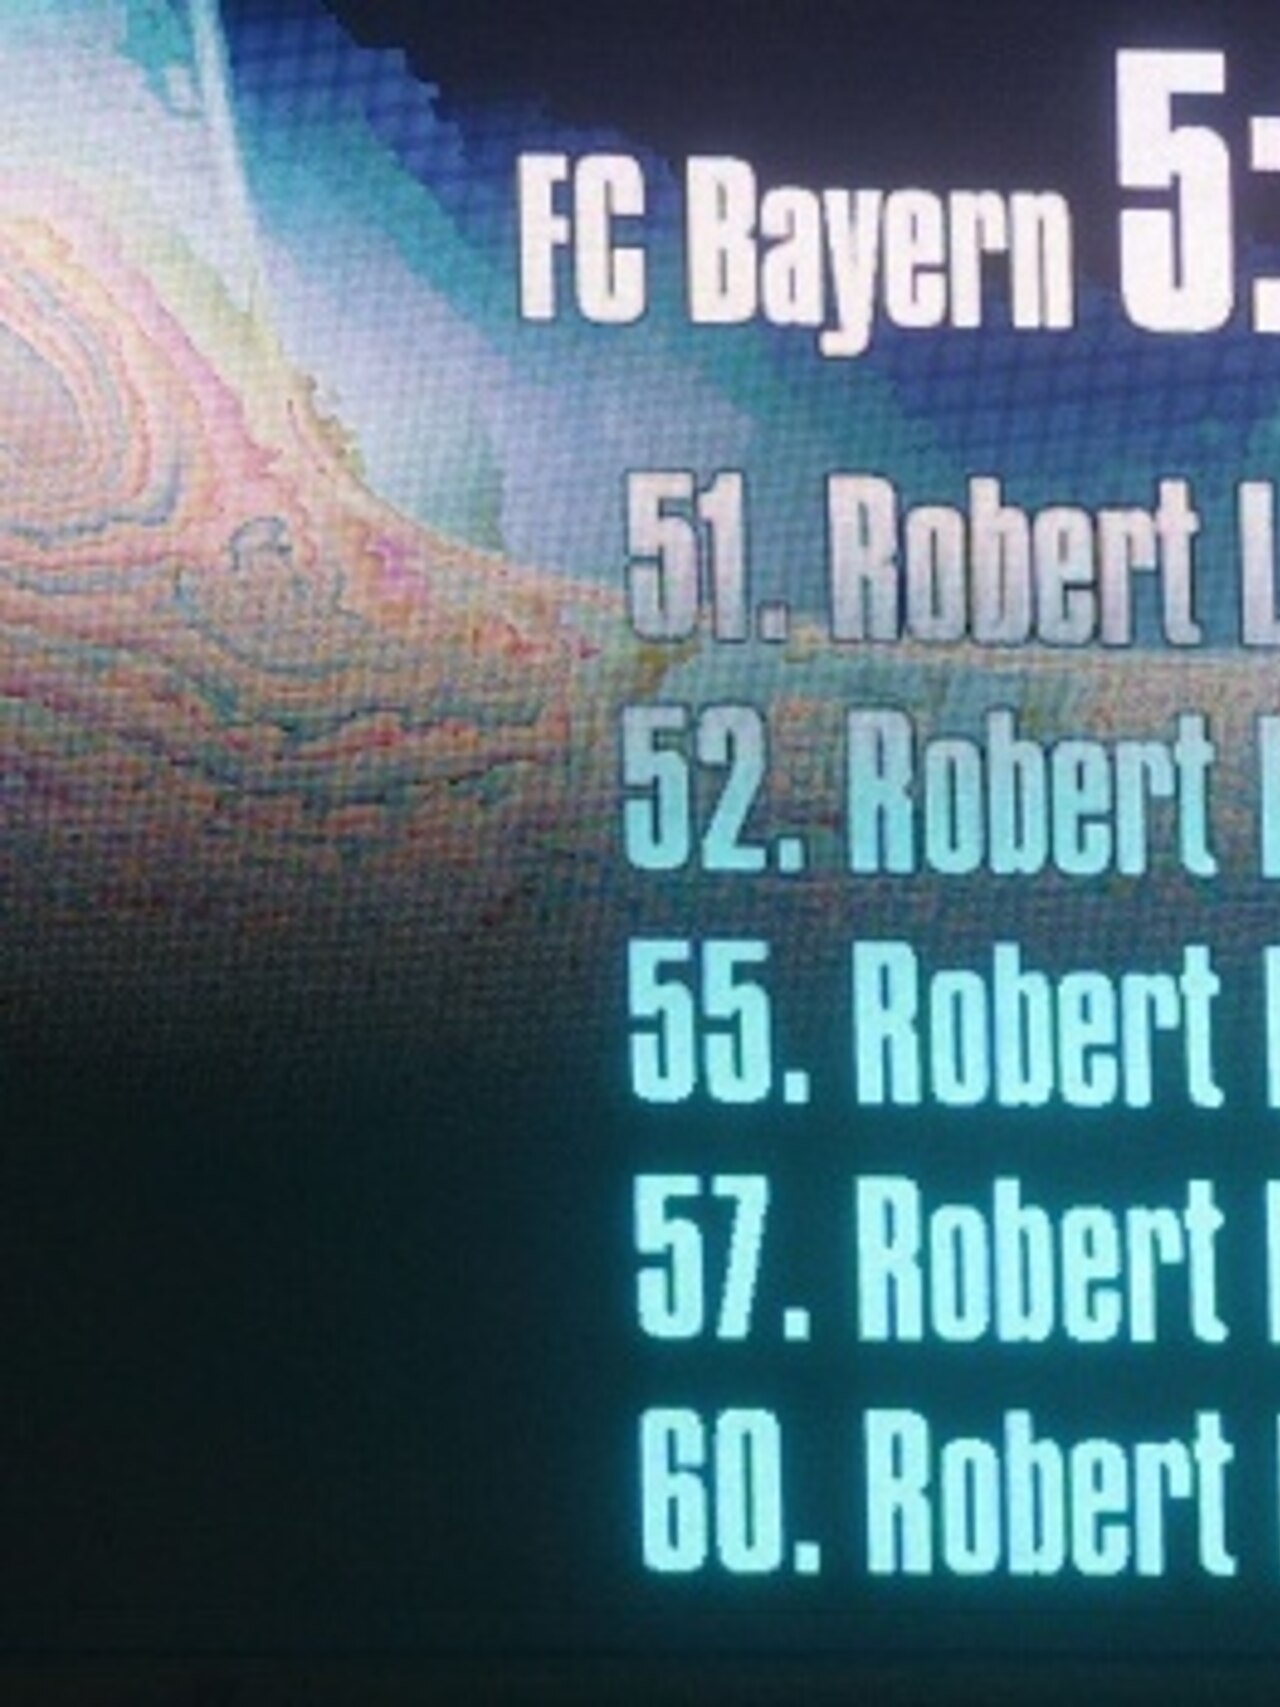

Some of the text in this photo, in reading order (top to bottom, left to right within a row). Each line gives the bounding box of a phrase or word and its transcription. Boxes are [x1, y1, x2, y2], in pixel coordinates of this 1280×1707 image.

[517, 152, 646, 324] FC
[685, 155, 1074, 357] Bayern
[626, 471, 788, 643] 51.
[826, 473, 1201, 646] Robert
[620, 705, 803, 871] 52.
[847, 706, 1217, 877] Robert
[627, 940, 809, 1103] 55.
[852, 941, 1224, 1108] Robert
[633, 1174, 809, 1341] 57.
[856, 1177, 1228, 1343] Robert
[639, 1407, 821, 1574] 60.
[864, 1407, 1236, 1577] Robert
